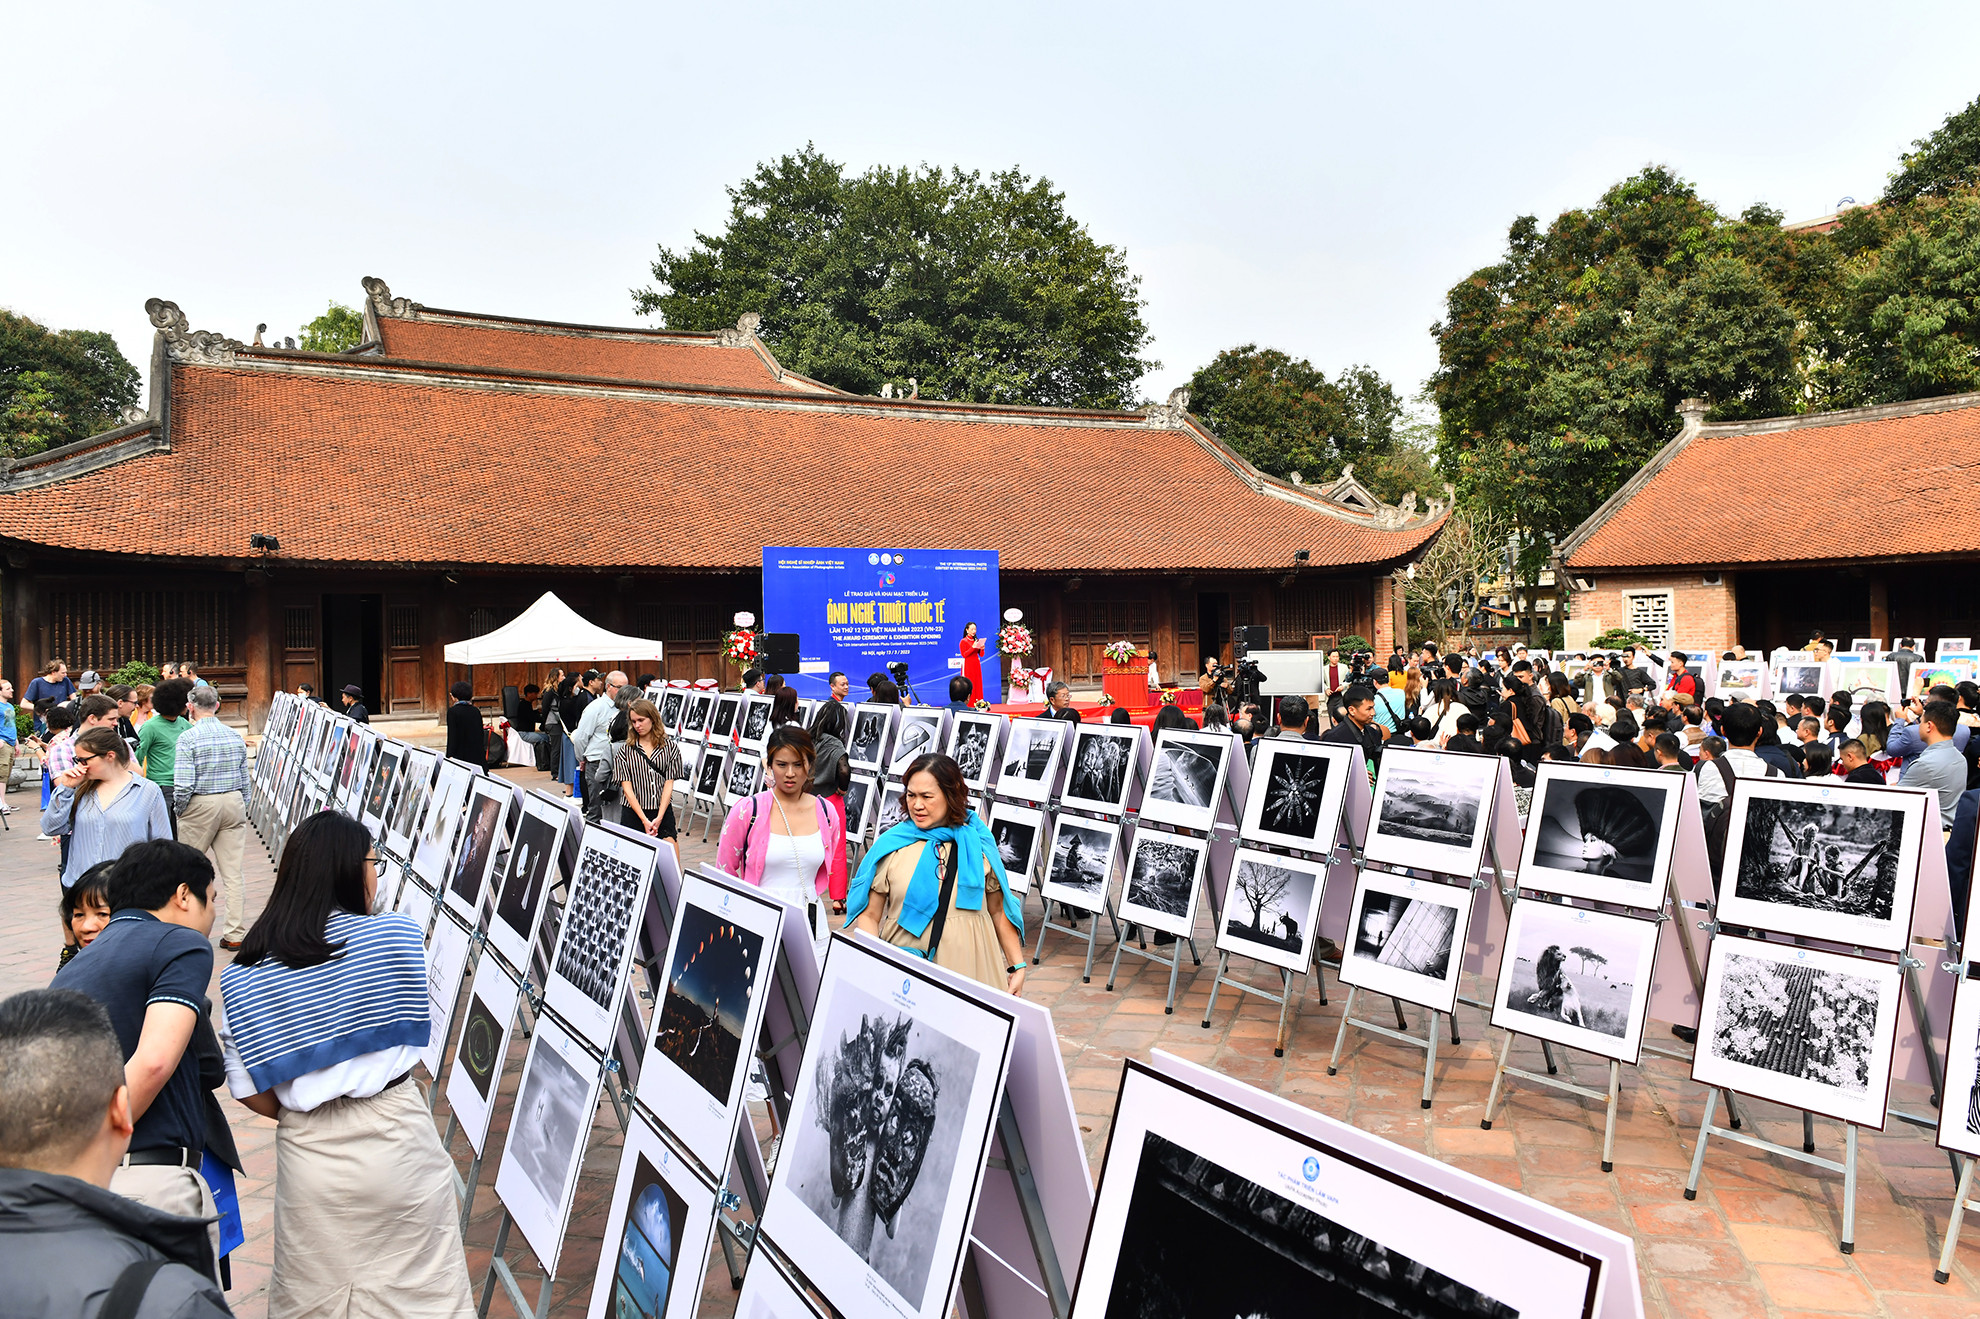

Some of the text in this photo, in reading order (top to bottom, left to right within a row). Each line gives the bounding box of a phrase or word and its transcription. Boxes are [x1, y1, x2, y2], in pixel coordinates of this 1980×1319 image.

[827, 598, 946, 625] ẢNH NGHỆ THUẬT QUỐC TẾ
